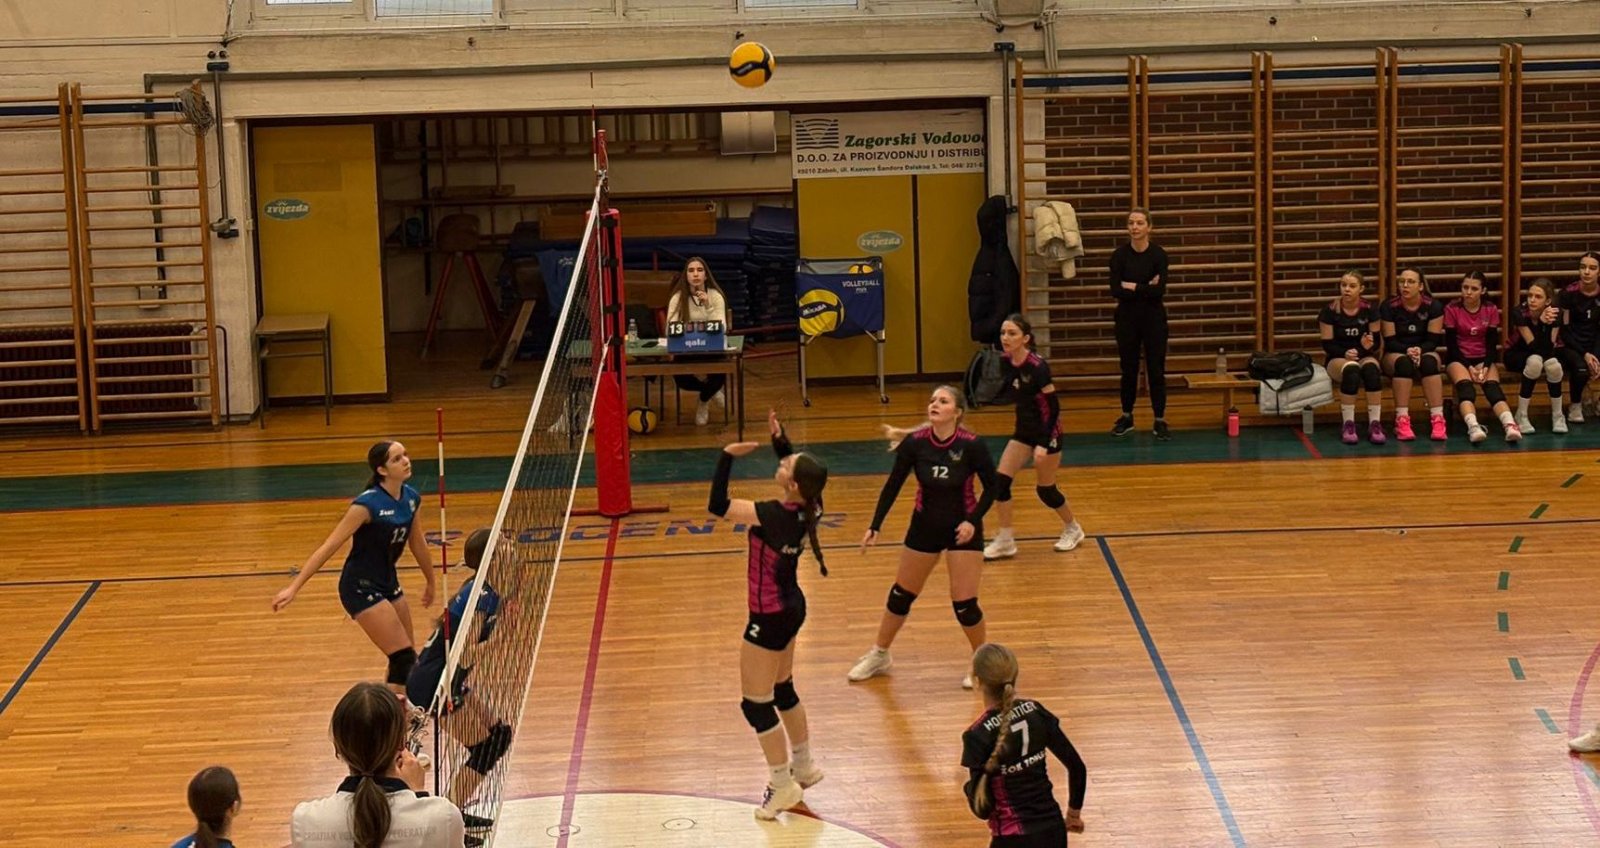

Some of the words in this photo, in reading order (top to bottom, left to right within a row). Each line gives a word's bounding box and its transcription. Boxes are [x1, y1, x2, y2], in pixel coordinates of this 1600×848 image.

[844, 133, 917, 150] Zagorski
[797, 153, 830, 163] D.O.O.
[832, 153, 847, 162] ZA
[850, 150, 928, 161] PROIZVODNJU
[930, 149, 934, 158] I
[266, 203, 309, 215] zvijezda
[842, 280, 880, 288] VOLLEYBALL
[1586, 309, 1592, 319] 1
[669, 323, 683, 335] 13
[706, 322, 720, 331] 21
[1345, 327, 1359, 336] 10
[931, 465, 949, 479] 12
[390, 526, 407, 545] 12
[749, 623, 760, 638] 2
[1009, 719, 1030, 757] 7
